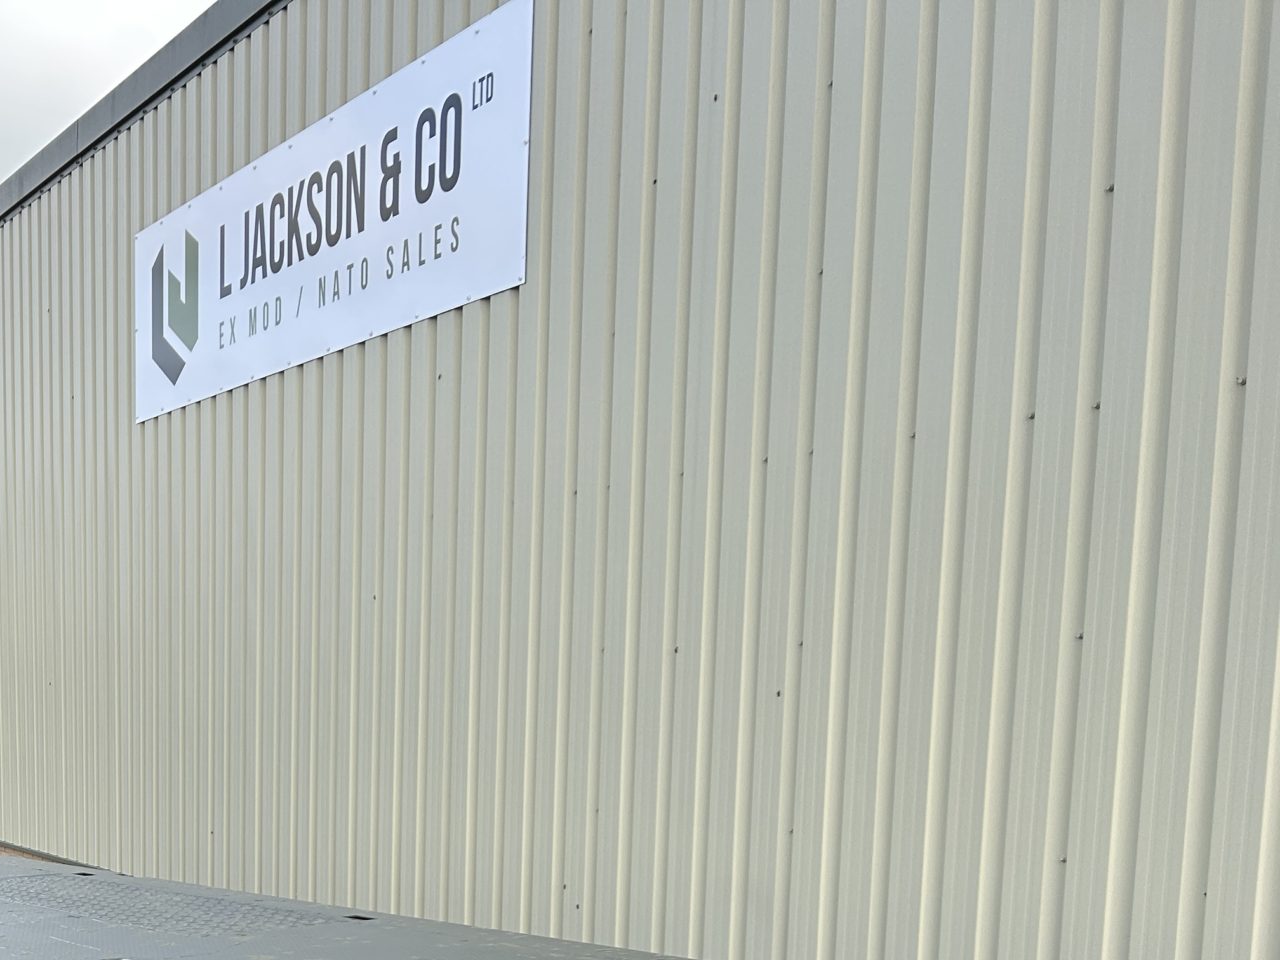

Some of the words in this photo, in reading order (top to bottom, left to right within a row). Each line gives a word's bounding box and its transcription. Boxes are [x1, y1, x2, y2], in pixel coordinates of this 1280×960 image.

[220, 224, 232, 299] L
[239, 144, 366, 291] JACKSON
[379, 126, 401, 222] &
[414, 92, 462, 204] CO
[472, 72, 494, 111] LTD
[219, 316, 236, 349] EX
[248, 296, 282, 336] MOD
[296, 286, 304, 317] /
[318, 257, 369, 309] NATO
[386, 216, 460, 280] SALES
